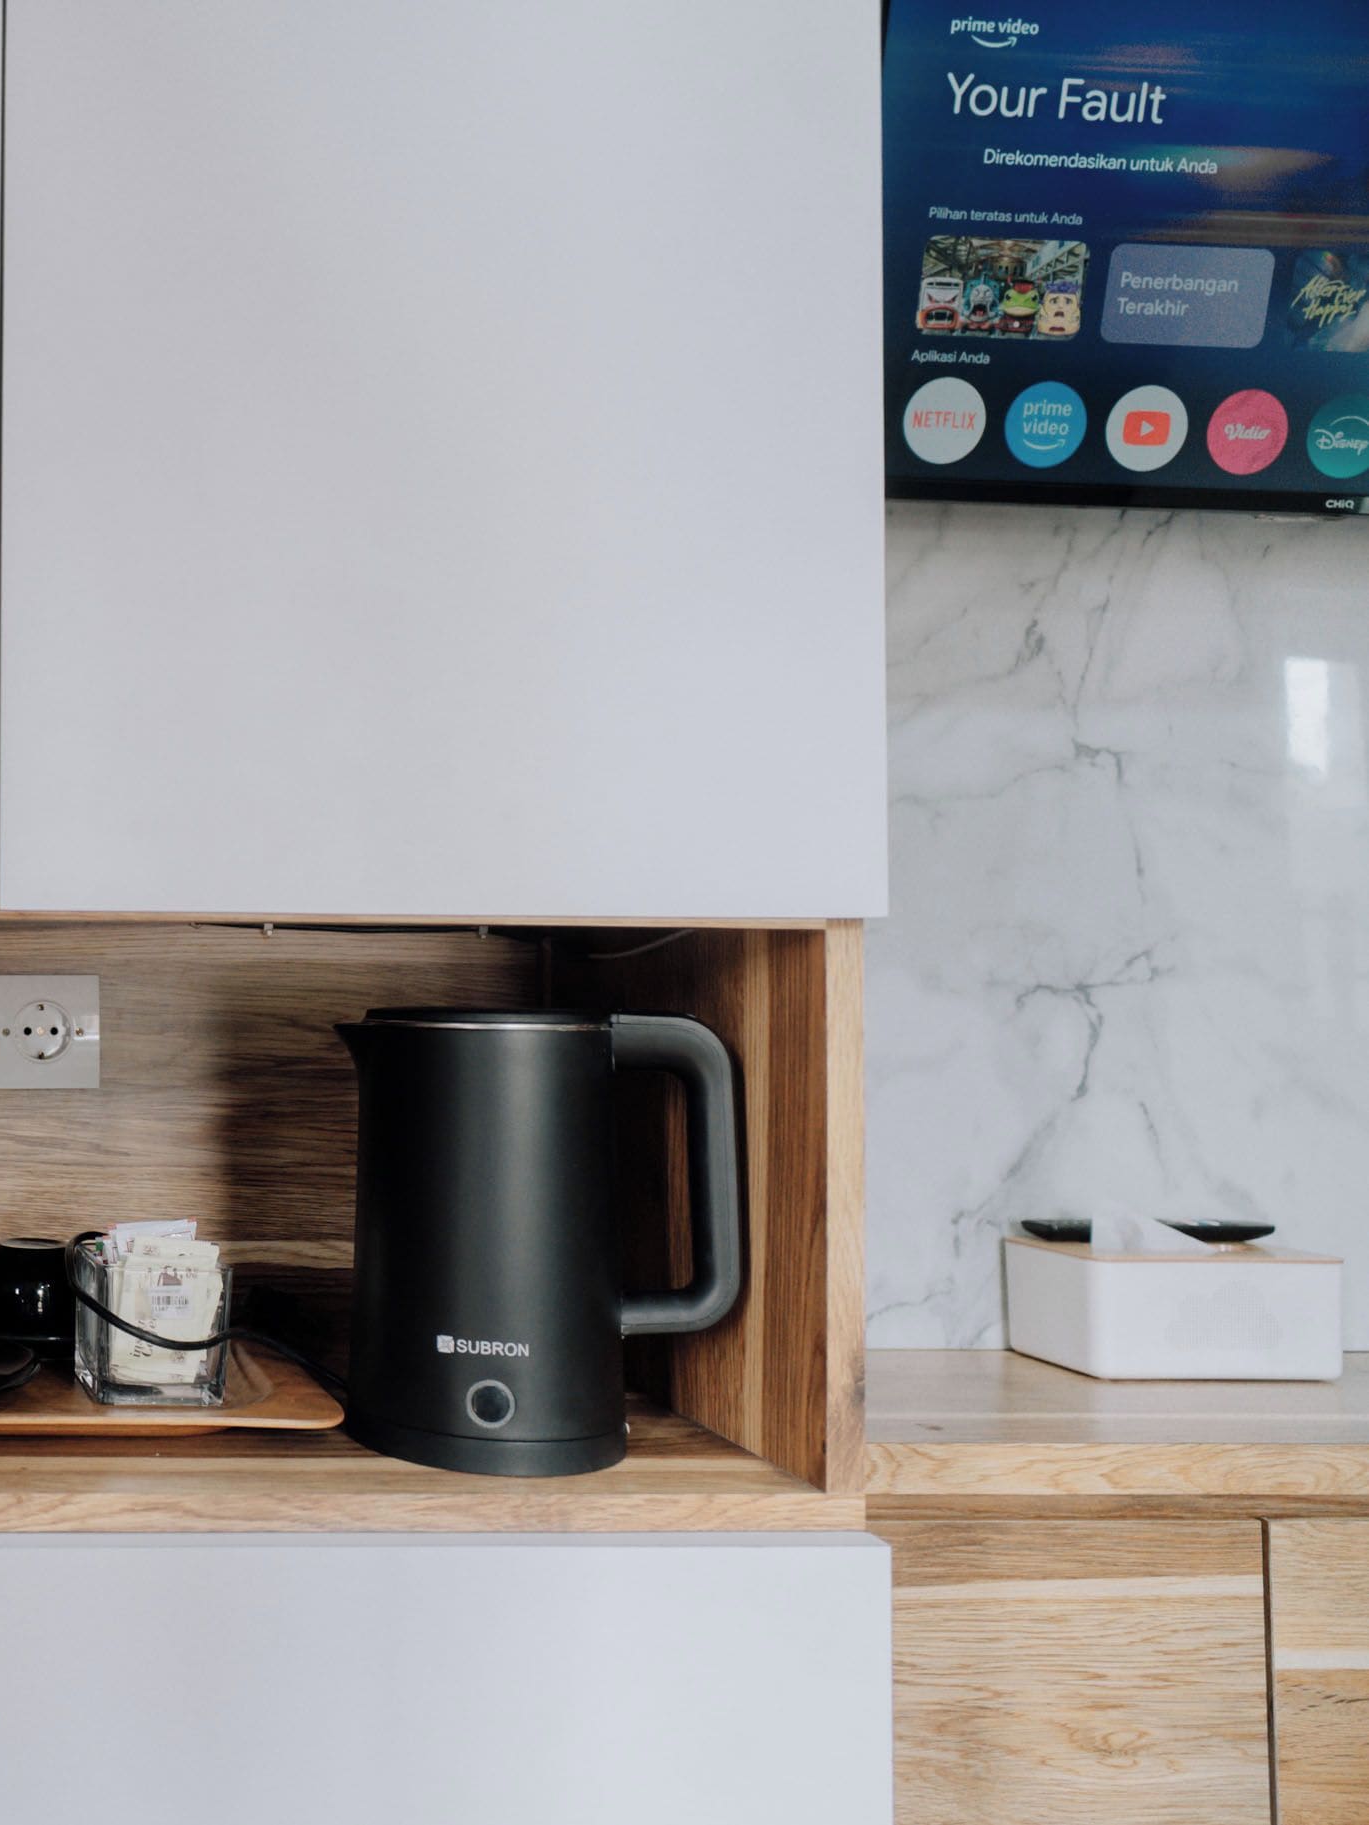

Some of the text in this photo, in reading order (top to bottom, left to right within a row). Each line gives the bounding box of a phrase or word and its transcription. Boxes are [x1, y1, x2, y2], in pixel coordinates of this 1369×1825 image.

[950, 16, 1039, 37] prime video
[947, 72, 1166, 125] Your Fault
[983, 148, 1218, 175] Direkomendasikan untuk Anda
[929, 206, 1083, 226] Pilihan teratas untuk Anda
[1120, 272, 1239, 294] Penerbangan
[1117, 298, 1189, 317] Terakhir
[911, 349, 991, 365] Aplikasi Anda
[1023, 400, 1072, 418] prime
[912, 410, 978, 431] NETFLIX
[1022, 418, 1069, 436] video
[1224, 422, 1271, 440] Vidio
[456, 1338, 530, 1357] SUBRON
